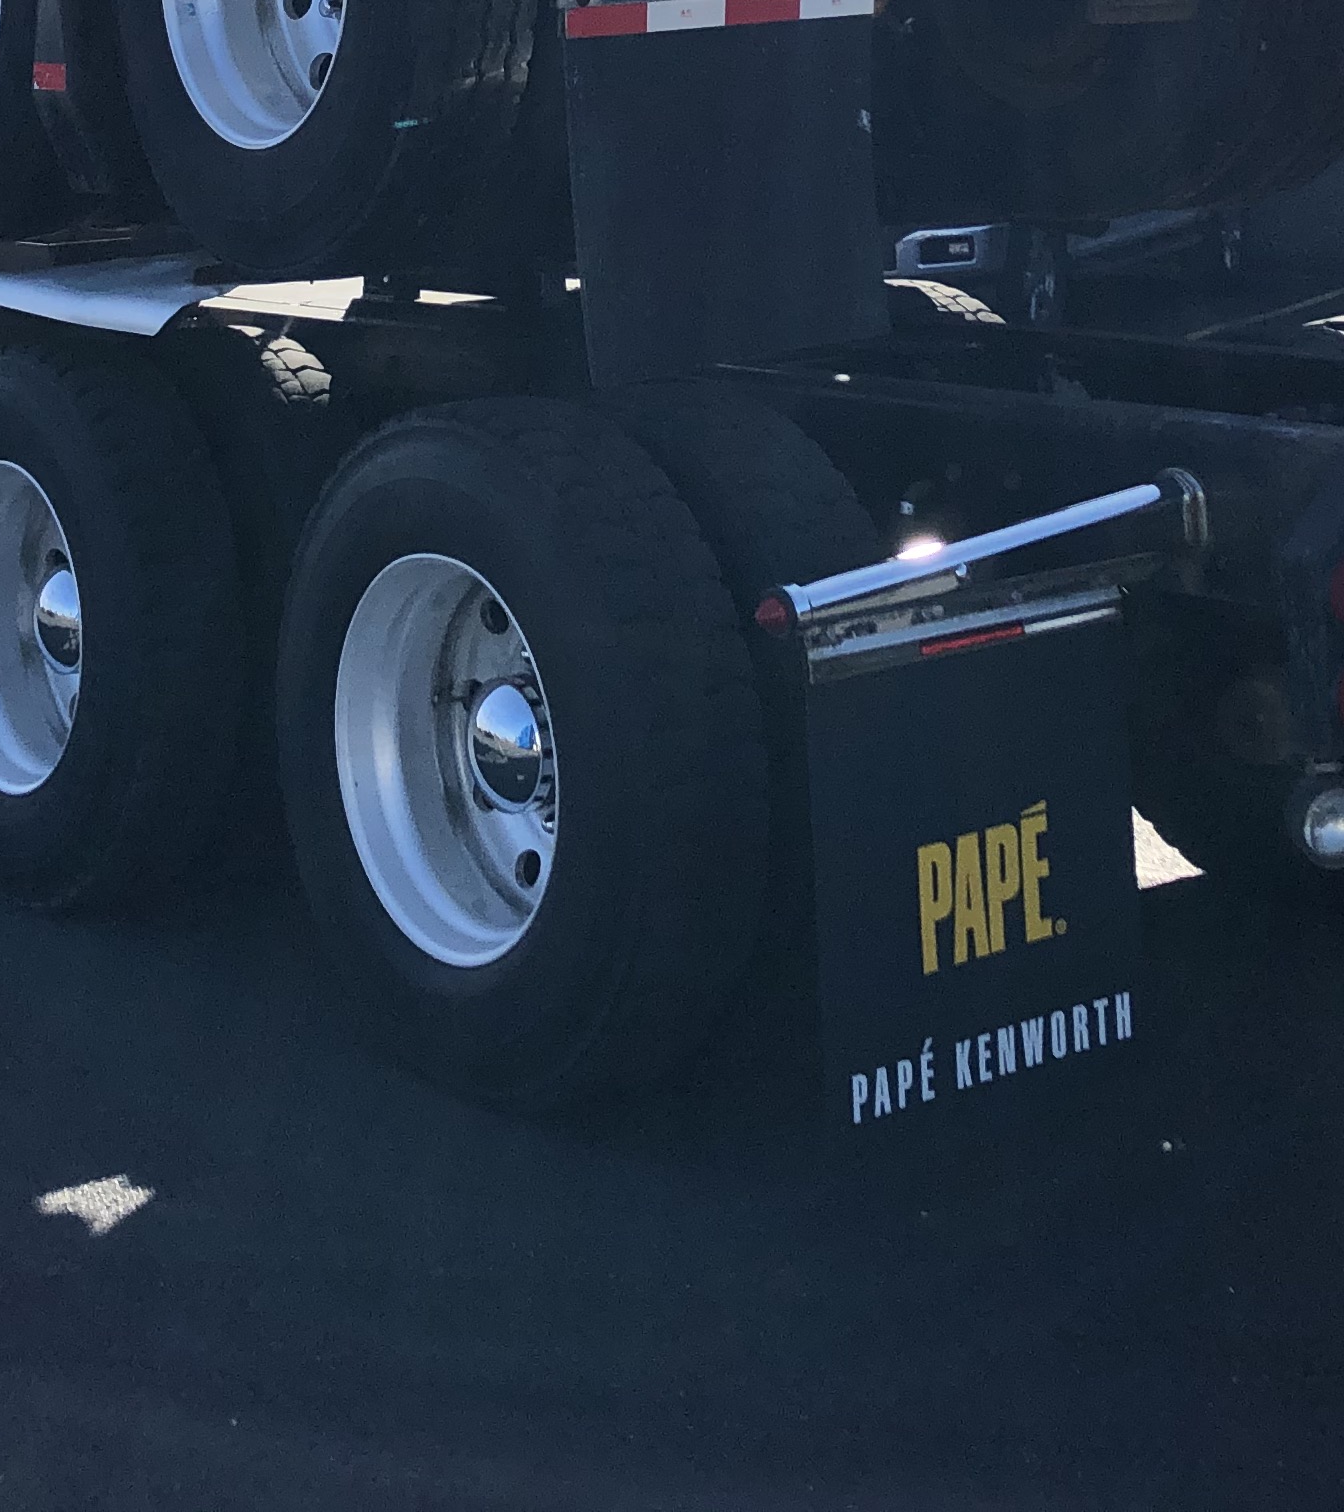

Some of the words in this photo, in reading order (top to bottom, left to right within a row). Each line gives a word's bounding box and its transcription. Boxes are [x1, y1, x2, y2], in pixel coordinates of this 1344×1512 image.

[917, 799, 1053, 975] PAPÉ
[851, 1037, 936, 1124] PAPÉ
[955, 992, 1133, 1090] KENWORTH
